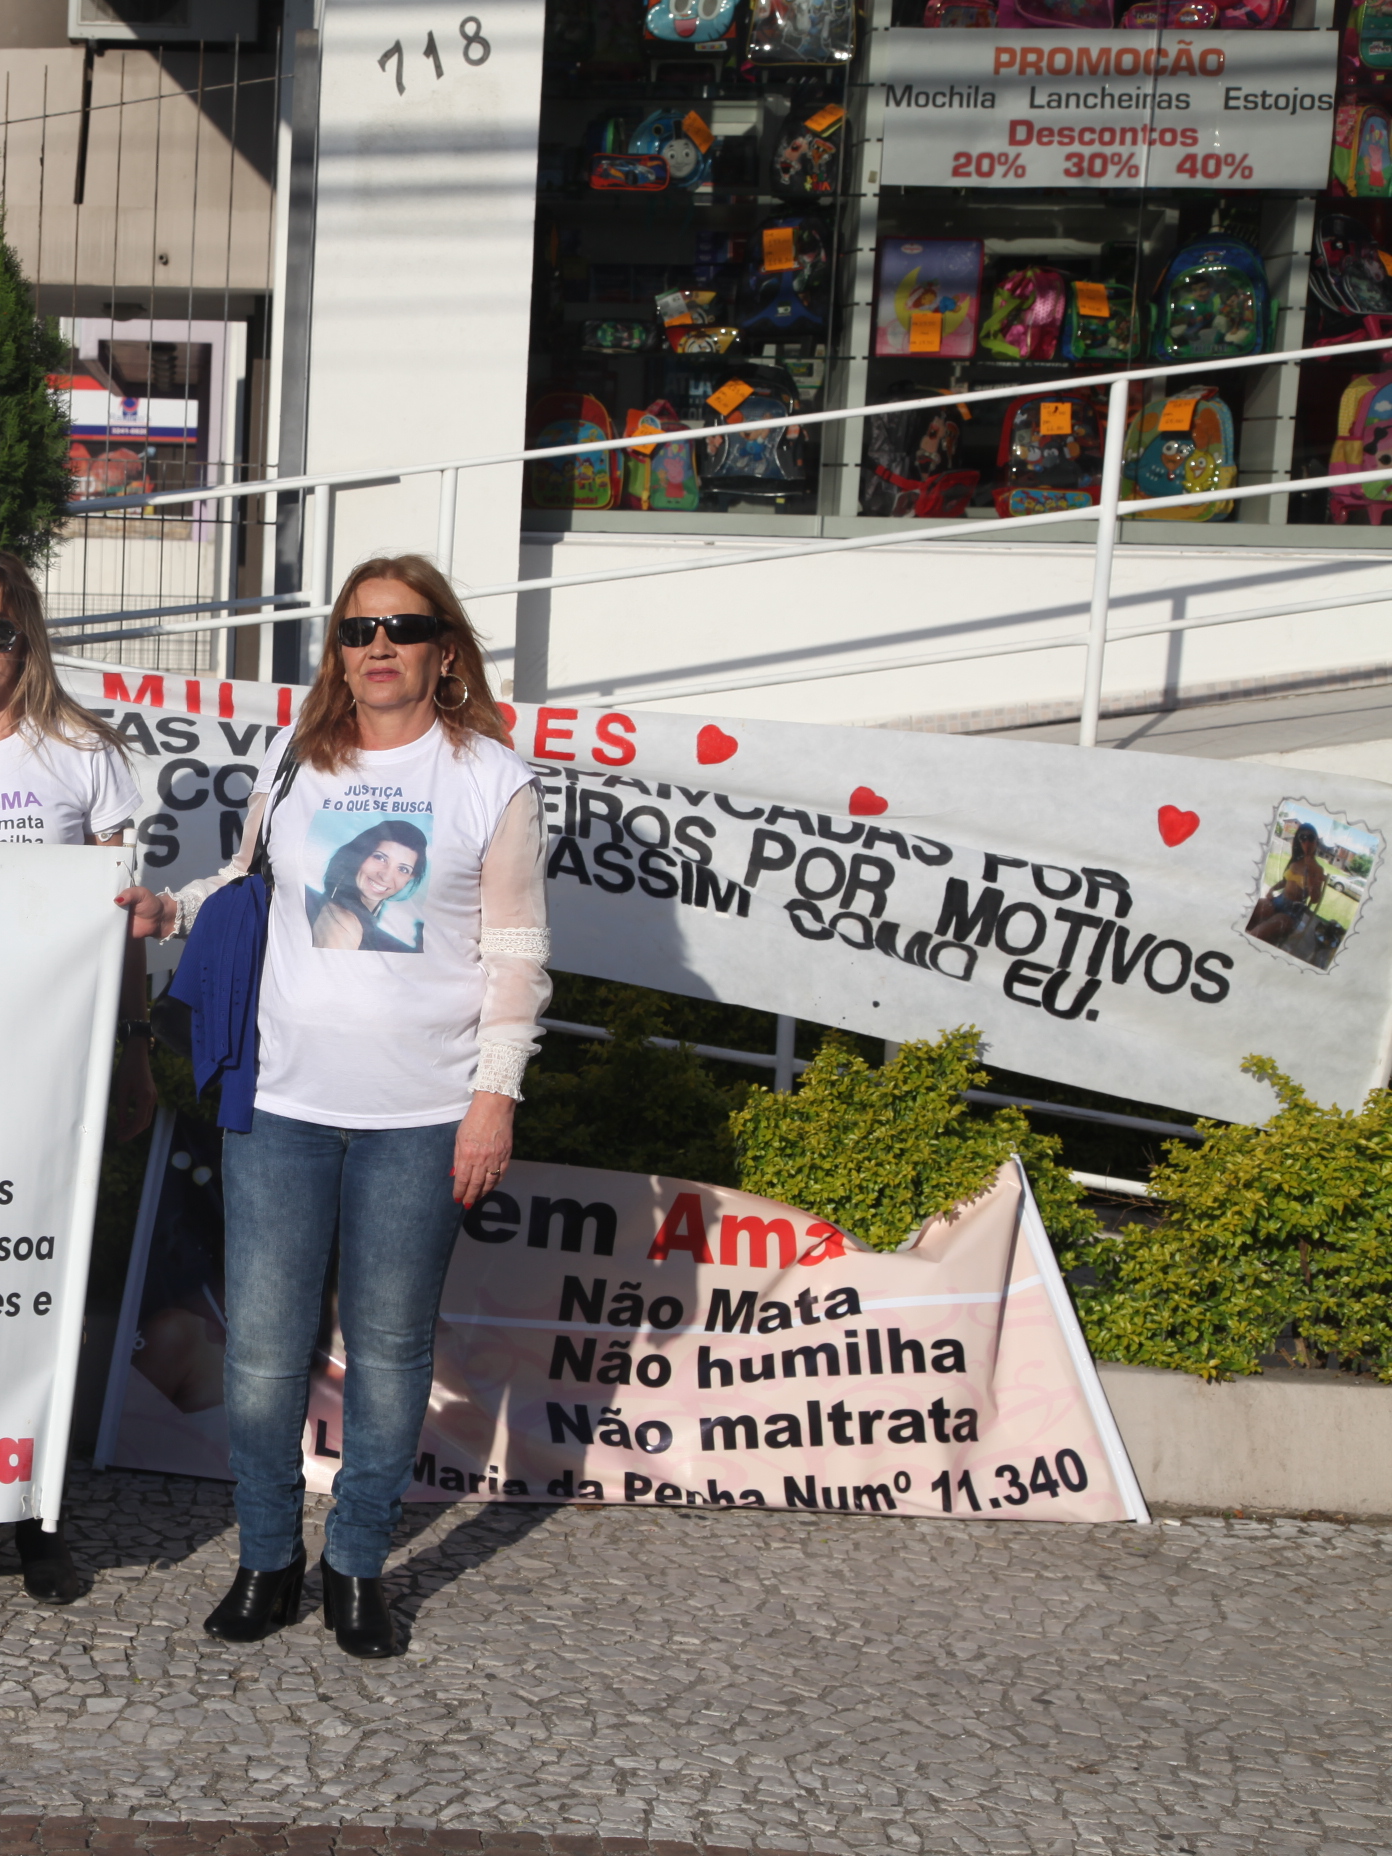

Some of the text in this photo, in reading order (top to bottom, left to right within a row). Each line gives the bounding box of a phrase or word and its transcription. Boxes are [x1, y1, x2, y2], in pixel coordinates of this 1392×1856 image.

[377, 16, 491, 96] 718
[885, 84, 1334, 115] Mochila Lancheiras Estojos
[1008, 119, 1199, 147] Descontos
[951, 152, 1253, 180] 20% 30% 40%
[322, 797, 433, 814] É O QUE SE BUSCA
[344, 784, 403, 799] JUSTIÇA
[546, 836, 751, 918] ASSIM
[783, 898, 979, 982] COMO
[1003, 959, 1102, 1022] EU.
[743, 828, 896, 919] POR
[935, 877, 1234, 1004] MOTIVOS
[646, 1192, 847, 1270] Ama
[33, 1291, 52, 1316] e
[558, 1275, 862, 1336] Não Mata
[548, 1328, 966, 1389] Não humilha
[546, 1398, 978, 1454] Não maltrata
[413, 1452, 530, 1497] Maria
[547, 1470, 604, 1500] da
[931, 1448, 1089, 1513] 11.340
